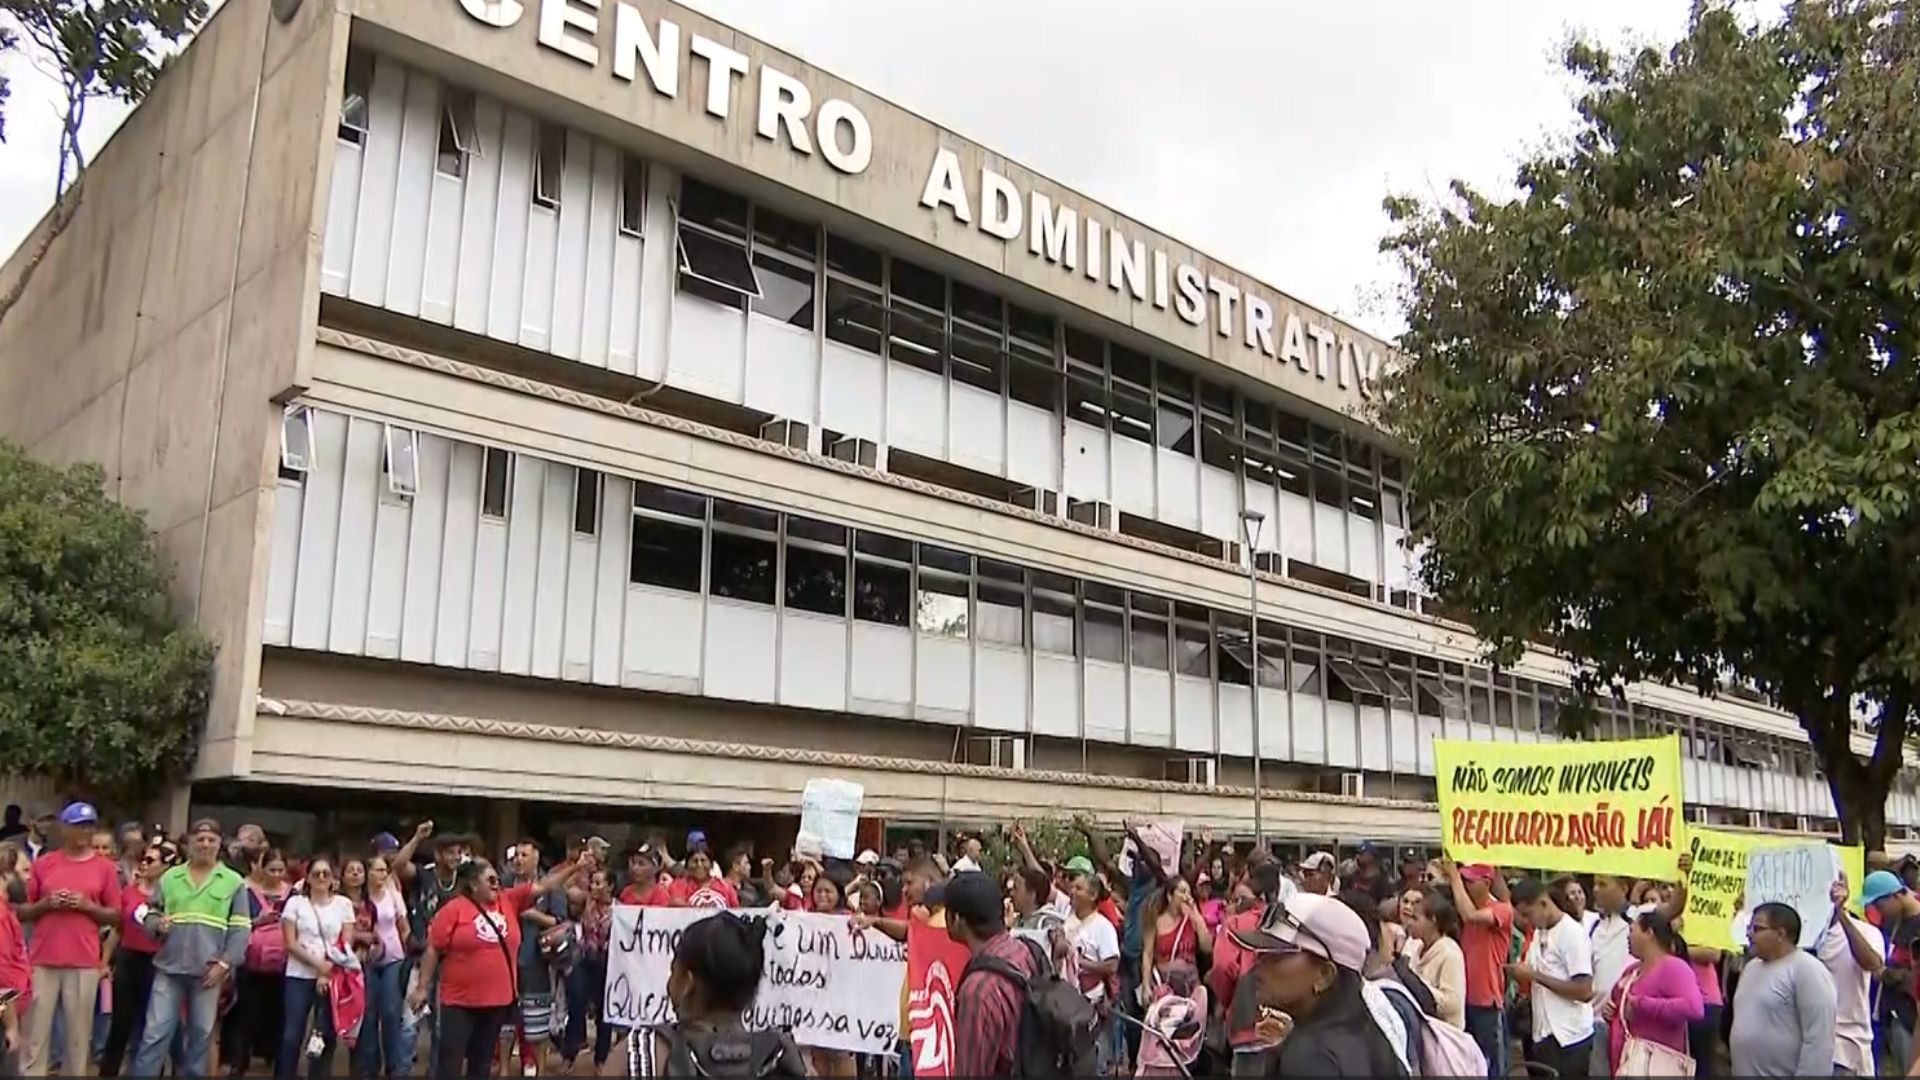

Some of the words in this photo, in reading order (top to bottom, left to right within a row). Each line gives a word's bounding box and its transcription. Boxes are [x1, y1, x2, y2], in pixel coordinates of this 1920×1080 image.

[920, 146, 1381, 399] ADMINISTRATIV
[1452, 761, 1488, 793] NÃO
[1493, 766, 1554, 796] SOMOS
[1452, 802, 1626, 855] REGULARIZAÇÃO
[1631, 795, 1674, 850] JÁ!
